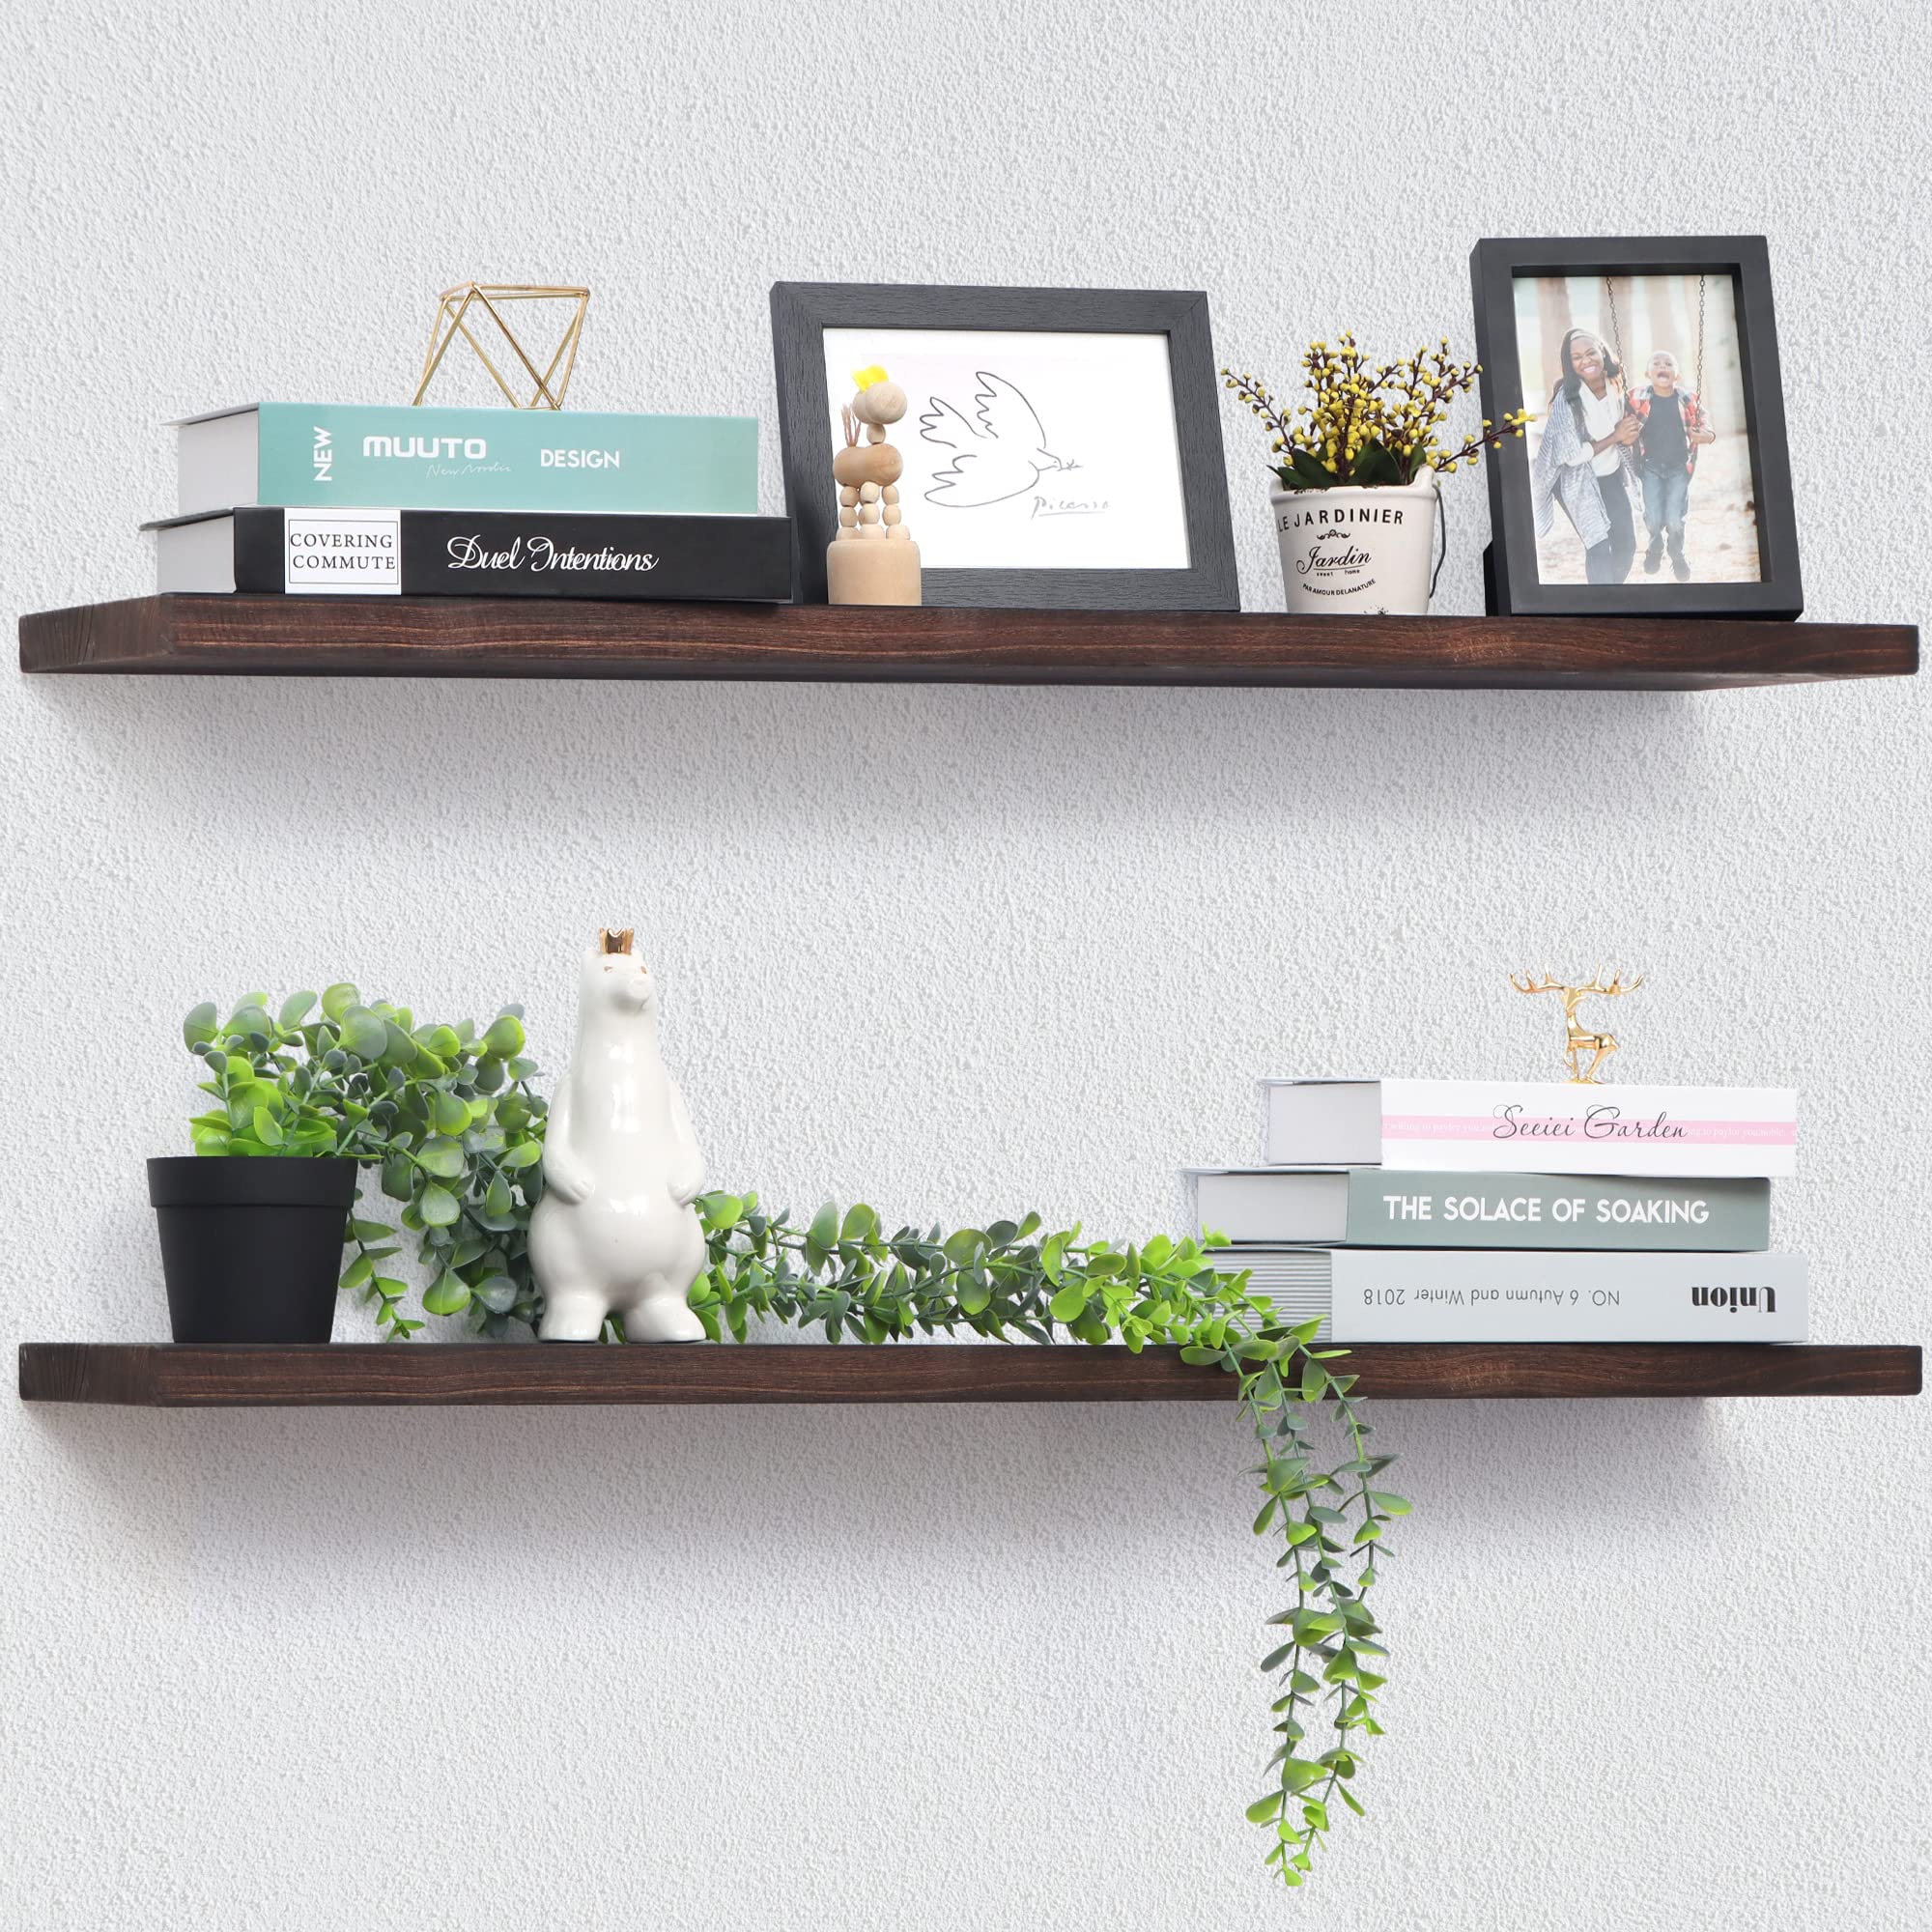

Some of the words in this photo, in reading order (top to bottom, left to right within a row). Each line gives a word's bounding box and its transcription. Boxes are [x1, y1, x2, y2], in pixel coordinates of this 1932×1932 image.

[313, 425, 333, 482] NEW
[362, 435, 487, 460] MUUTO
[540, 448, 620, 469] DESIGN
[1278, 515, 1291, 532] LE
[1293, 508, 1405, 528] JARDINIER
[290, 532, 393, 549] COVERING
[293, 554, 396, 570] COMMUTE
[446, 533, 526, 570] Duel
[526, 536, 660, 572] Intentions
[1295, 545, 1372, 575] Jardin
[1313, 587, 1335, 596] AMOUR
[1583, 1104, 1688, 1139] Garden
[1382, 1195, 1433, 1221] THE
[1443, 1196, 1542, 1222] SOLACE
[1551, 1197, 1586, 1223] OF
[1596, 1199, 1710, 1224] SOAKING
[1363, 1289, 1406, 1306] 2018
[1413, 1289, 1464, 1306] Winter
[1470, 1289, 1500, 1306] and
[1505, 1289, 1564, 1306] Autumn
[1569, 1289, 1579, 1306] 6
[1588, 1290, 1621, 1306] NO.
[1690, 1286, 1776, 1314] Union
